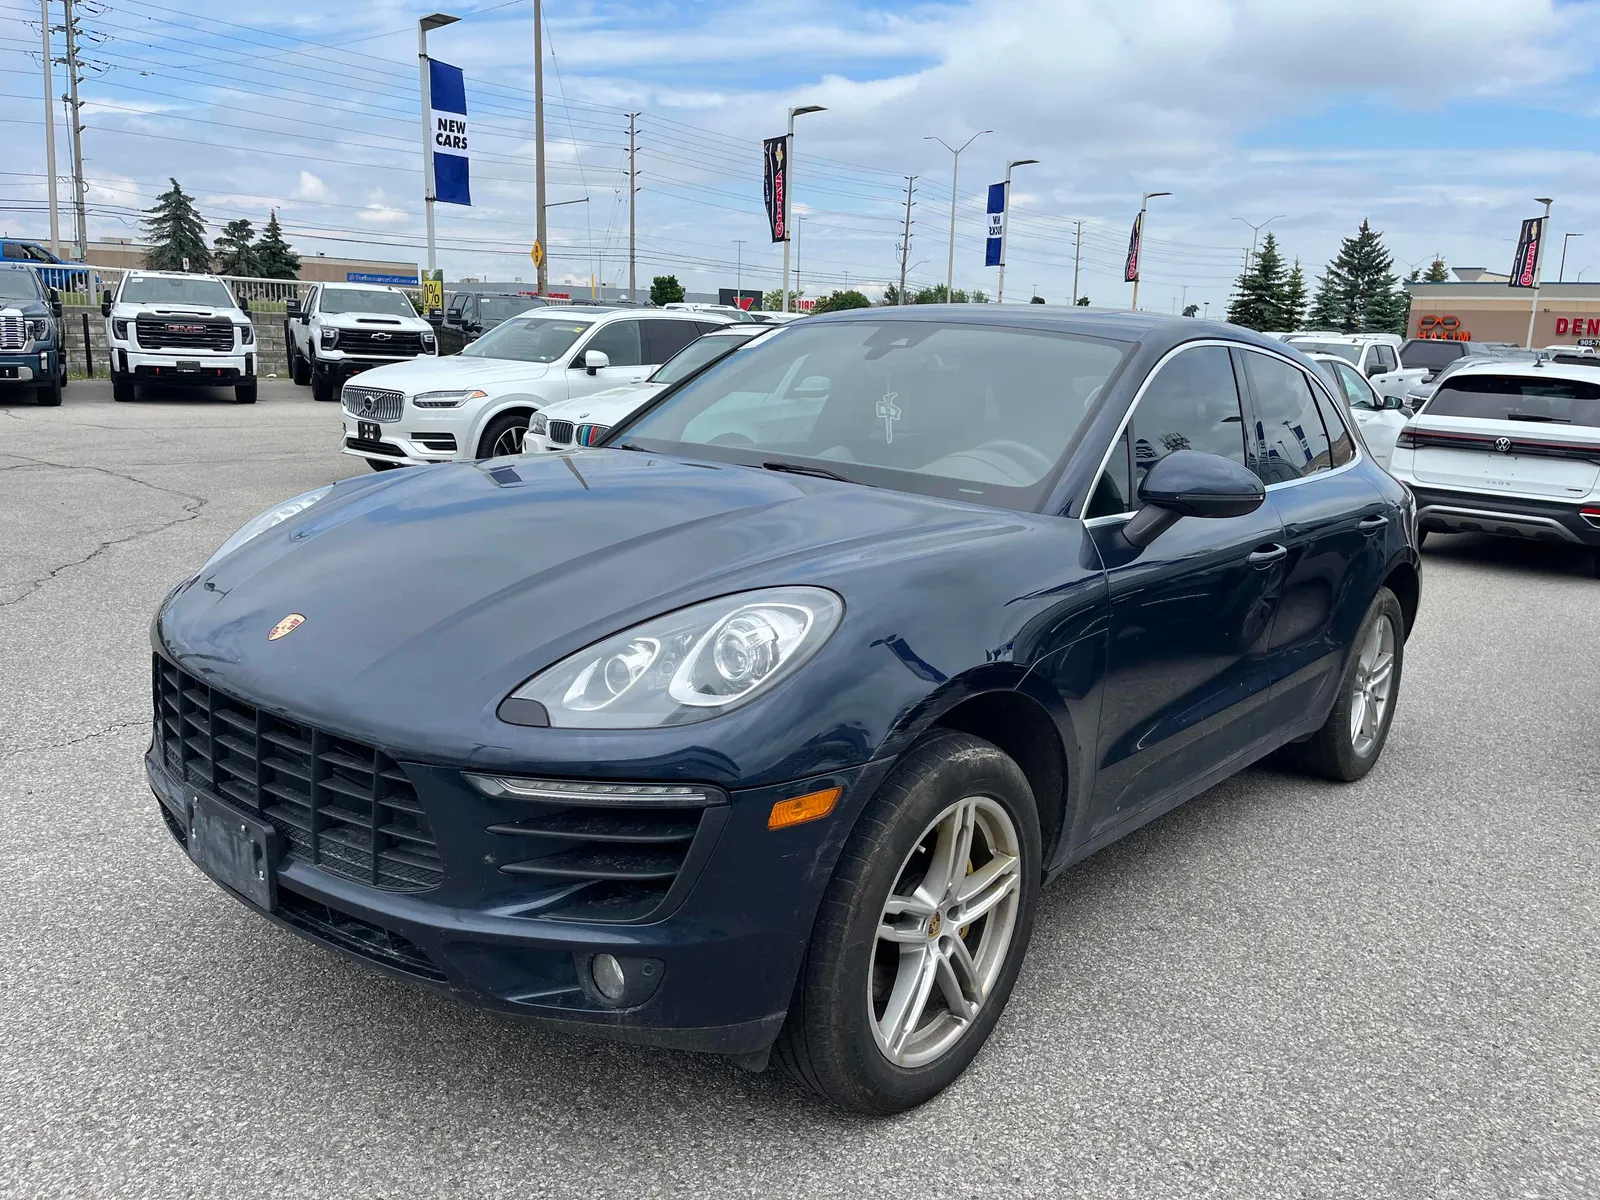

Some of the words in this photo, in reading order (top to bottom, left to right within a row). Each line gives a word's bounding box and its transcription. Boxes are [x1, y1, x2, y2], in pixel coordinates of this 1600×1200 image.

[437, 118, 466, 134] NEW
[436, 133, 468, 150] CARS
[167, 325, 204, 333] GMC
[1417, 331, 1471, 342] HAKIM
